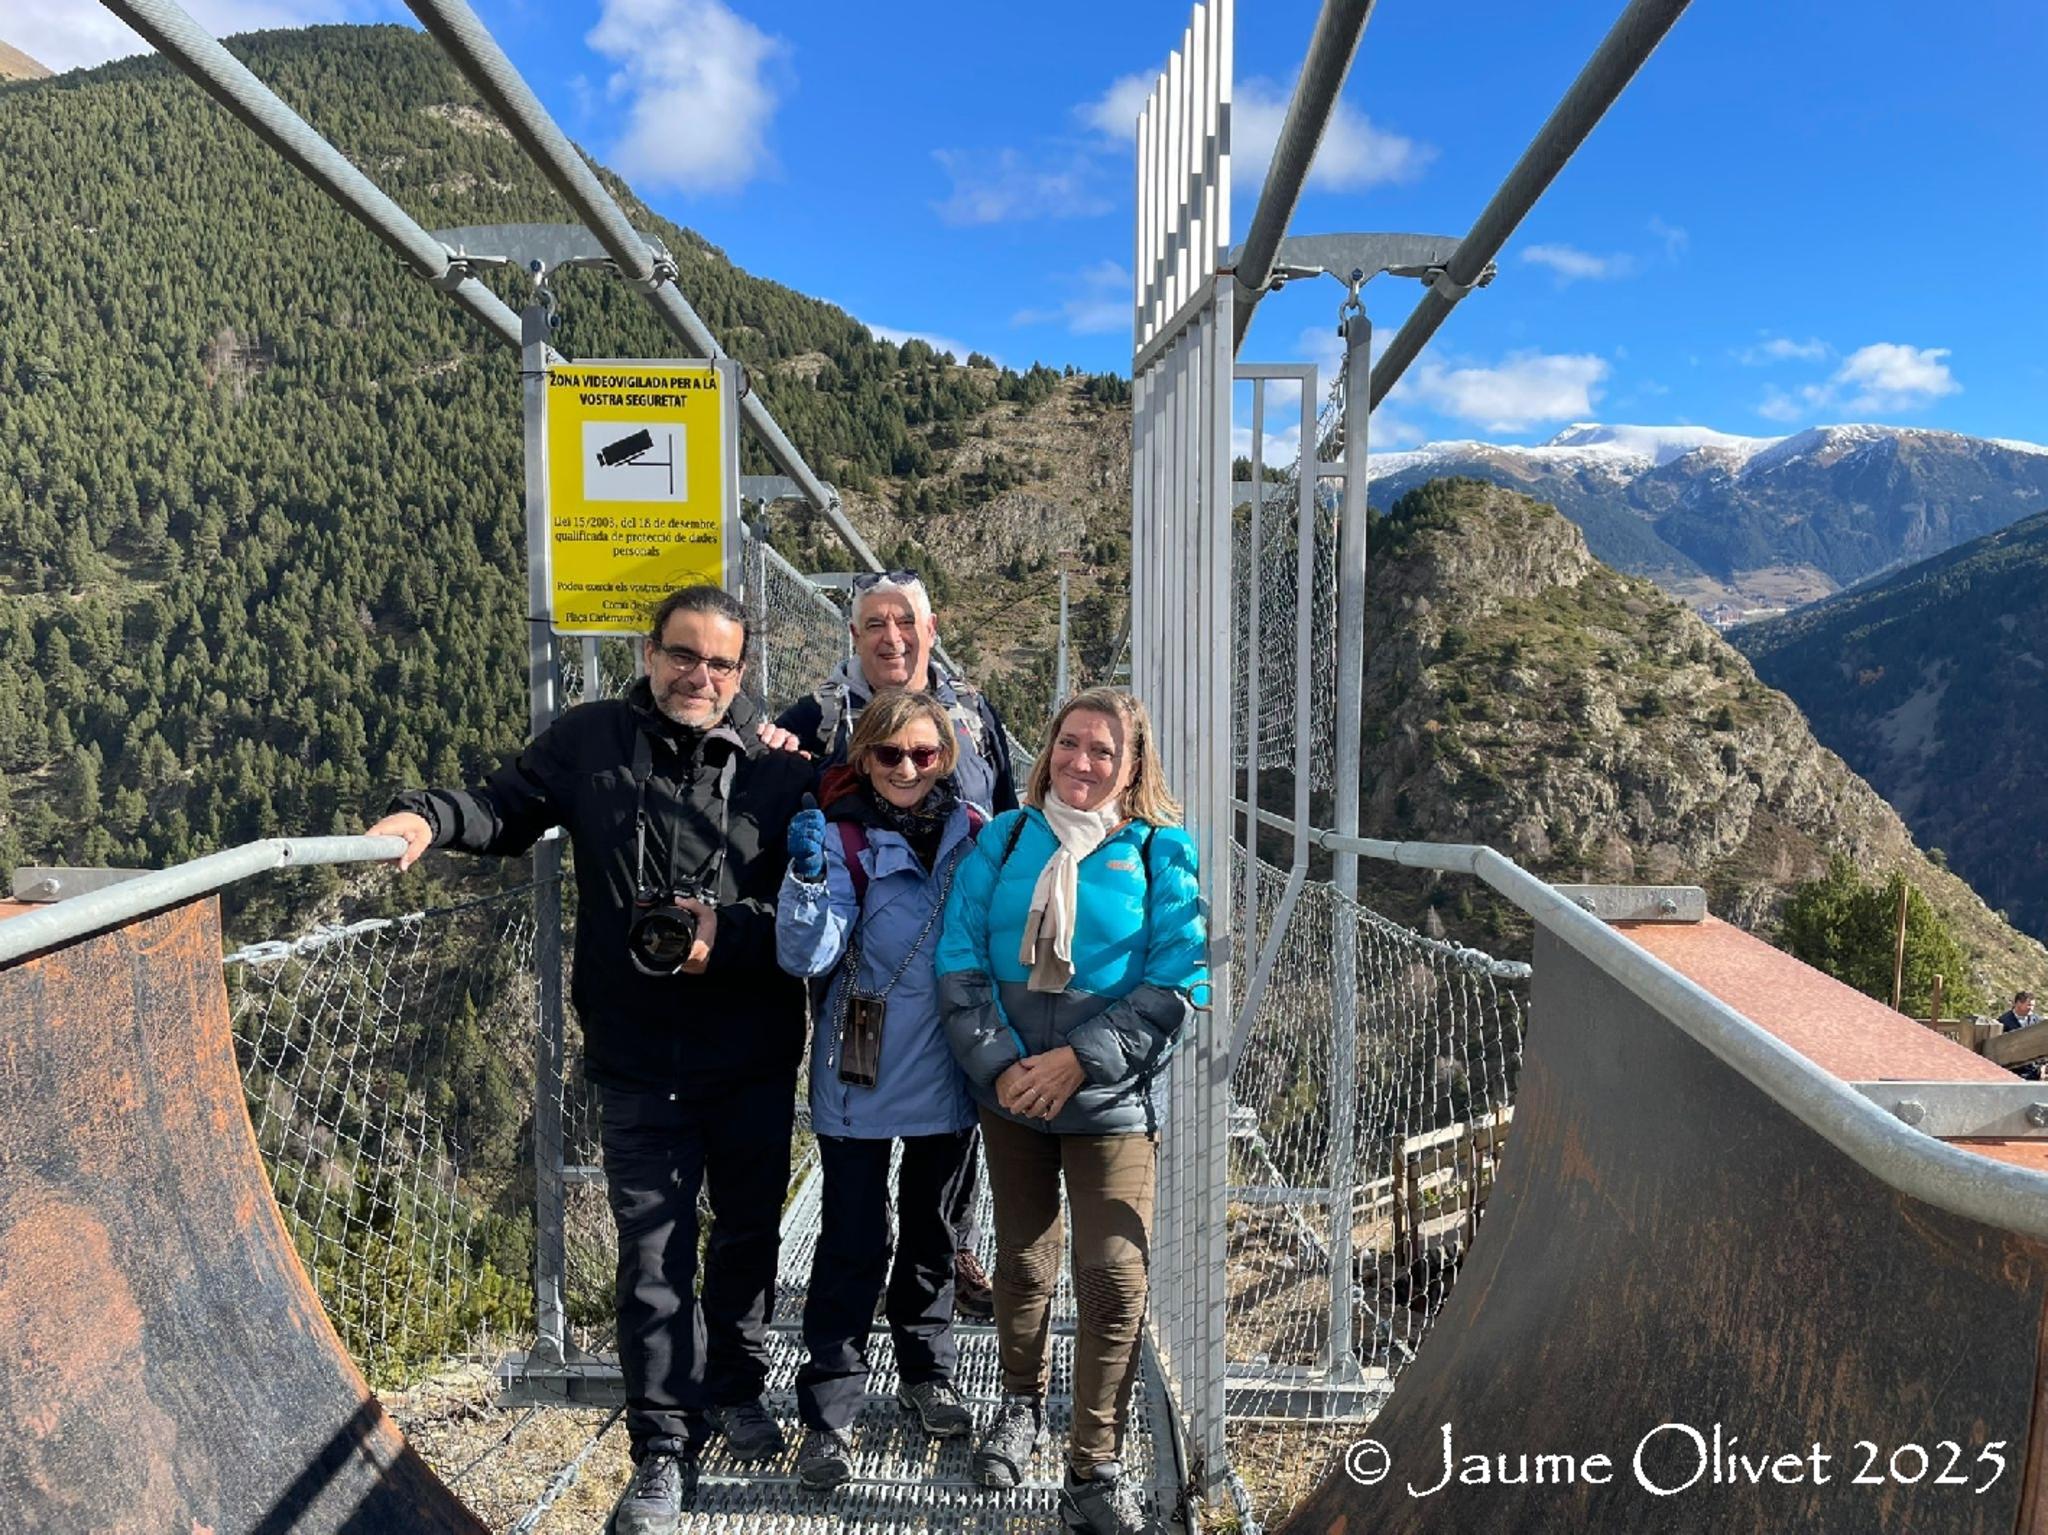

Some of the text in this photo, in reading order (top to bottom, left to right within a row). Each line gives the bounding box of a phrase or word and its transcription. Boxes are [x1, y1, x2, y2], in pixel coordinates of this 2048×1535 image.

[550, 373, 717, 389] ZONA VIDEOVIGILADA PER A LA
[580, 393, 687, 407] VOSTRA SEGURETAT
[621, 517, 636, 528] del
[654, 518, 665, 528] de
[555, 530, 608, 542] qualificada
[611, 530, 623, 541] de
[674, 532, 686, 542] de
[613, 546, 660, 557] personals
[615, 582, 628, 592] els
